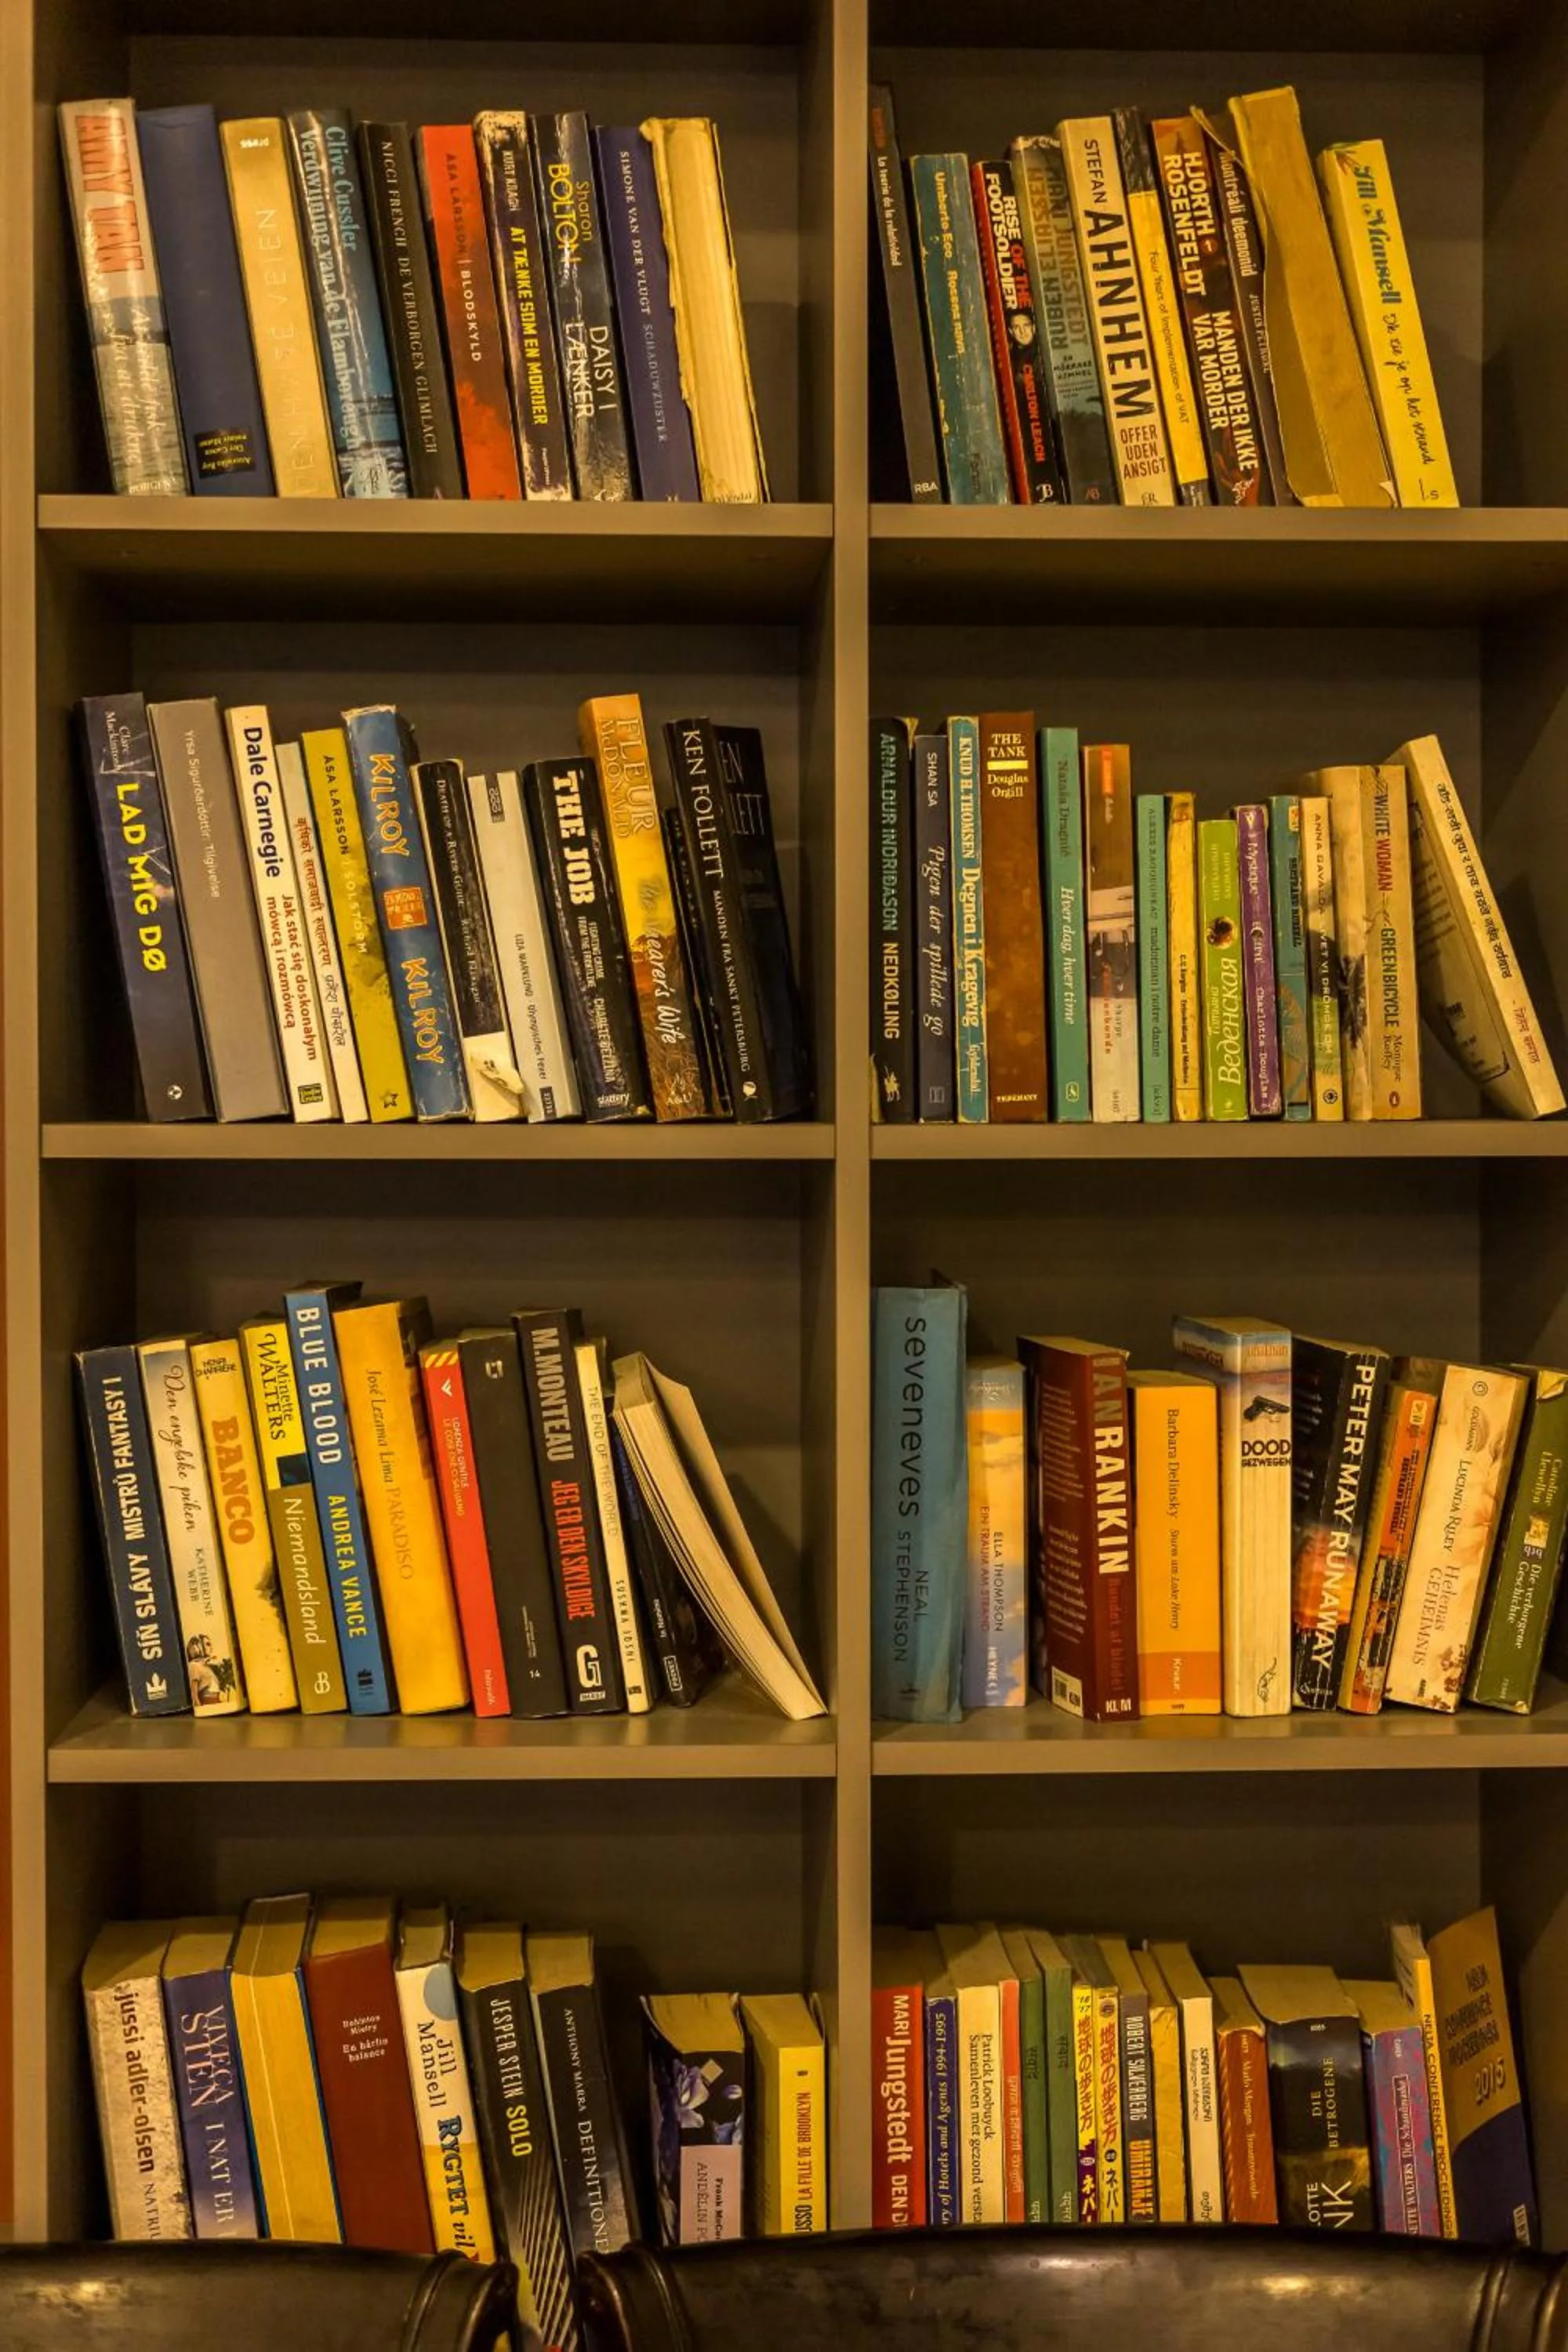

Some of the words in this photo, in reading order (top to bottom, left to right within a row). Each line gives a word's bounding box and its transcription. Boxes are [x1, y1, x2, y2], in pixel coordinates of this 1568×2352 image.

[78, 114, 134, 197] AMY
[324, 125, 350, 176] Clive
[382, 141, 396, 184] NICCI
[1084, 139, 1107, 205] STEFAN
[620, 151, 635, 202] SIMONE
[1184, 151, 1216, 234] HJORTH
[332, 180, 360, 251] Cussler
[390, 191, 405, 247] FRENCH
[451, 187, 470, 254] LARSSON
[510, 227, 526, 245] AT
[548, 163, 581, 263] BOLTON
[577, 180, 593, 241] Sharon
[627, 207, 641, 234] VAN
[1003, 195, 1020, 239] RISE
[1163, 154, 1205, 296] ROSENFELDT
[89, 201, 144, 274] TAN
[632, 239, 645, 265] DER
[942, 233, 954, 259] Eco
[985, 173, 1018, 310] FOOTSOLDIER
[1011, 245, 1025, 267] OF
[1362, 205, 1401, 303] Mansell
[316, 249, 335, 281] van
[397, 257, 410, 278] DE
[512, 249, 532, 299] TÆNKE
[460, 270, 481, 362] BLODSKYLD
[636, 270, 652, 315] VLUGT
[1084, 209, 1155, 419] AHNHEM
[401, 282, 423, 370] VERBORGEN
[520, 302, 536, 335] SOM
[1192, 313, 1212, 350] VAR
[524, 339, 539, 359] EN
[589, 325, 614, 394] DAISY
[1213, 310, 1243, 388] MANDEN
[415, 376, 437, 453] GLIMLACH
[1178, 405, 1189, 424] VAT
[1197, 354, 1228, 430] MORDER
[1227, 391, 1251, 426] DER
[1120, 424, 1158, 444] OFFER
[1125, 442, 1158, 461] UDEN
[1233, 430, 1258, 471] IKKE
[914, 481, 938, 494] RBA
[1123, 458, 1167, 480] ANSIGT
[243, 727, 269, 775] Dale
[682, 730, 706, 775] KEN
[959, 738, 974, 776] KNUD
[988, 746, 1026, 759] TANK
[992, 733, 1022, 746] THE
[616, 717, 654, 834] FLEUR
[880, 733, 897, 823] ARNALDUR
[927, 753, 938, 786] SHAN
[991, 786, 1023, 798] Orgill
[115, 782, 145, 845] LAD
[328, 789, 350, 855] LARSSON
[369, 753, 409, 857] KILROY
[553, 771, 583, 838] THE
[927, 791, 938, 806] SA
[1374, 795, 1390, 837] WHITE
[251, 782, 283, 877] Carnegie
[691, 785, 724, 878] FOLLETT
[1314, 814, 1323, 851] ANNA
[127, 855, 161, 915] MIG
[200, 844, 222, 898] Tilgivelse
[562, 847, 596, 905] JOB
[1315, 855, 1327, 915] GAVALDA
[1376, 839, 1393, 891] WOMAN
[280, 895, 296, 916] Jak
[712, 891, 729, 940] MANDEN
[927, 906, 944, 933] der
[1060, 887, 1076, 920] Hver
[137, 926, 168, 972] DØ
[720, 943, 732, 962] FRA
[1063, 957, 1076, 988] hver
[1381, 928, 1396, 973] GREEN
[274, 957, 298, 1029] rozmówcą
[724, 967, 739, 1000] SANKT
[883, 942, 899, 1040] NEDKØLING
[1064, 993, 1077, 1025] time
[1383, 975, 1399, 1028] BICYCLE
[401, 958, 445, 1063] KILROY
[656, 1005, 685, 1044] Wife
[1218, 958, 1241, 1083] Веденская
[296, 1308, 327, 1369] BLUE
[278, 1364, 296, 1421] Minette
[531, 1328, 573, 1462] M.MONTEAU
[587, 1387, 600, 1410] THE
[898, 1317, 928, 1518] seveneves
[1343, 1365, 1375, 1454] PETER
[103, 1390, 134, 1468] FANTASY
[308, 1382, 341, 1465] BLOOD
[590, 1414, 604, 1437] END
[1167, 1409, 1180, 1458] Barbara
[1241, 1440, 1291, 1457] DOOD
[379, 1452, 394, 1483] Lima
[594, 1443, 608, 1458] OF
[212, 1417, 254, 1545] BANCO
[551, 1480, 579, 1505] JEG
[1094, 1428, 1129, 1575] RANKIN
[1167, 1462, 1180, 1518] Delinsky
[1332, 1462, 1359, 1524] MAY
[328, 1495, 357, 1570] ANDREA
[555, 1508, 581, 1525] ER
[557, 1528, 584, 1555] DEN
[1443, 1516, 1461, 1552] RILEY
[993, 1531, 1004, 1558] ELLA
[129, 1554, 160, 1617] SLÁVY
[284, 1497, 325, 1645] Niemandsland
[894, 1530, 911, 1663] STEPHENSON
[914, 1570, 929, 1622] NEAL
[1529, 1563, 1543, 1584] Die
[340, 1577, 367, 1638] VANCE
[993, 1563, 1004, 1632] THOMPSON
[1311, 1530, 1348, 1669] RUNAWAY
[1512, 1586, 1538, 1650] verborgene
[114, 1991, 144, 2044] jussi
[489, 1999, 517, 2052] JESPER
[893, 1994, 910, 2034] MARI
[1126, 2016, 1146, 2056] ROBERT
[180, 2013, 217, 2108] STEN
[205, 2005, 234, 2105] VIVECA
[417, 2020, 445, 2107] Mansell
[435, 2039, 456, 2076] Jill
[563, 2009, 580, 2067] ANTHONY
[572, 2071, 586, 2111] MARRA
[935, 2013, 946, 2076] 1994-1995
[982, 2034, 994, 2077] Patrick
[498, 2056, 524, 2099] STEIN
[881, 2036, 913, 2163] Jungstedt
[969, 2034, 982, 2114] Samenleven
[1127, 2059, 1147, 2121] SILVERBERG
[125, 2050, 157, 2173] adler-olsen
[796, 2092, 813, 2143] BROOKLYN
[936, 2082, 949, 2122] Agents
[971, 2115, 981, 2136] met
[982, 2079, 995, 2140] Loobuyck
[1311, 2091, 1323, 2117] DIE
[1327, 2057, 1338, 2147] BETROGENE
[506, 2106, 532, 2157] SOLO
[797, 2145, 811, 2158] DE
[938, 2125, 949, 2147] and
[207, 2133, 230, 2183] NAT
[437, 2115, 470, 2216] RYGTET
[939, 2150, 951, 2190] Hotels
[969, 2138, 983, 2184] gezond
[1128, 2139, 1153, 2216] UMIRANJE
[212, 2192, 232, 2223] ER
[714, 2178, 724, 2207] Frank
[797, 2187, 811, 2201] LA
[891, 2174, 910, 2209] DEN
